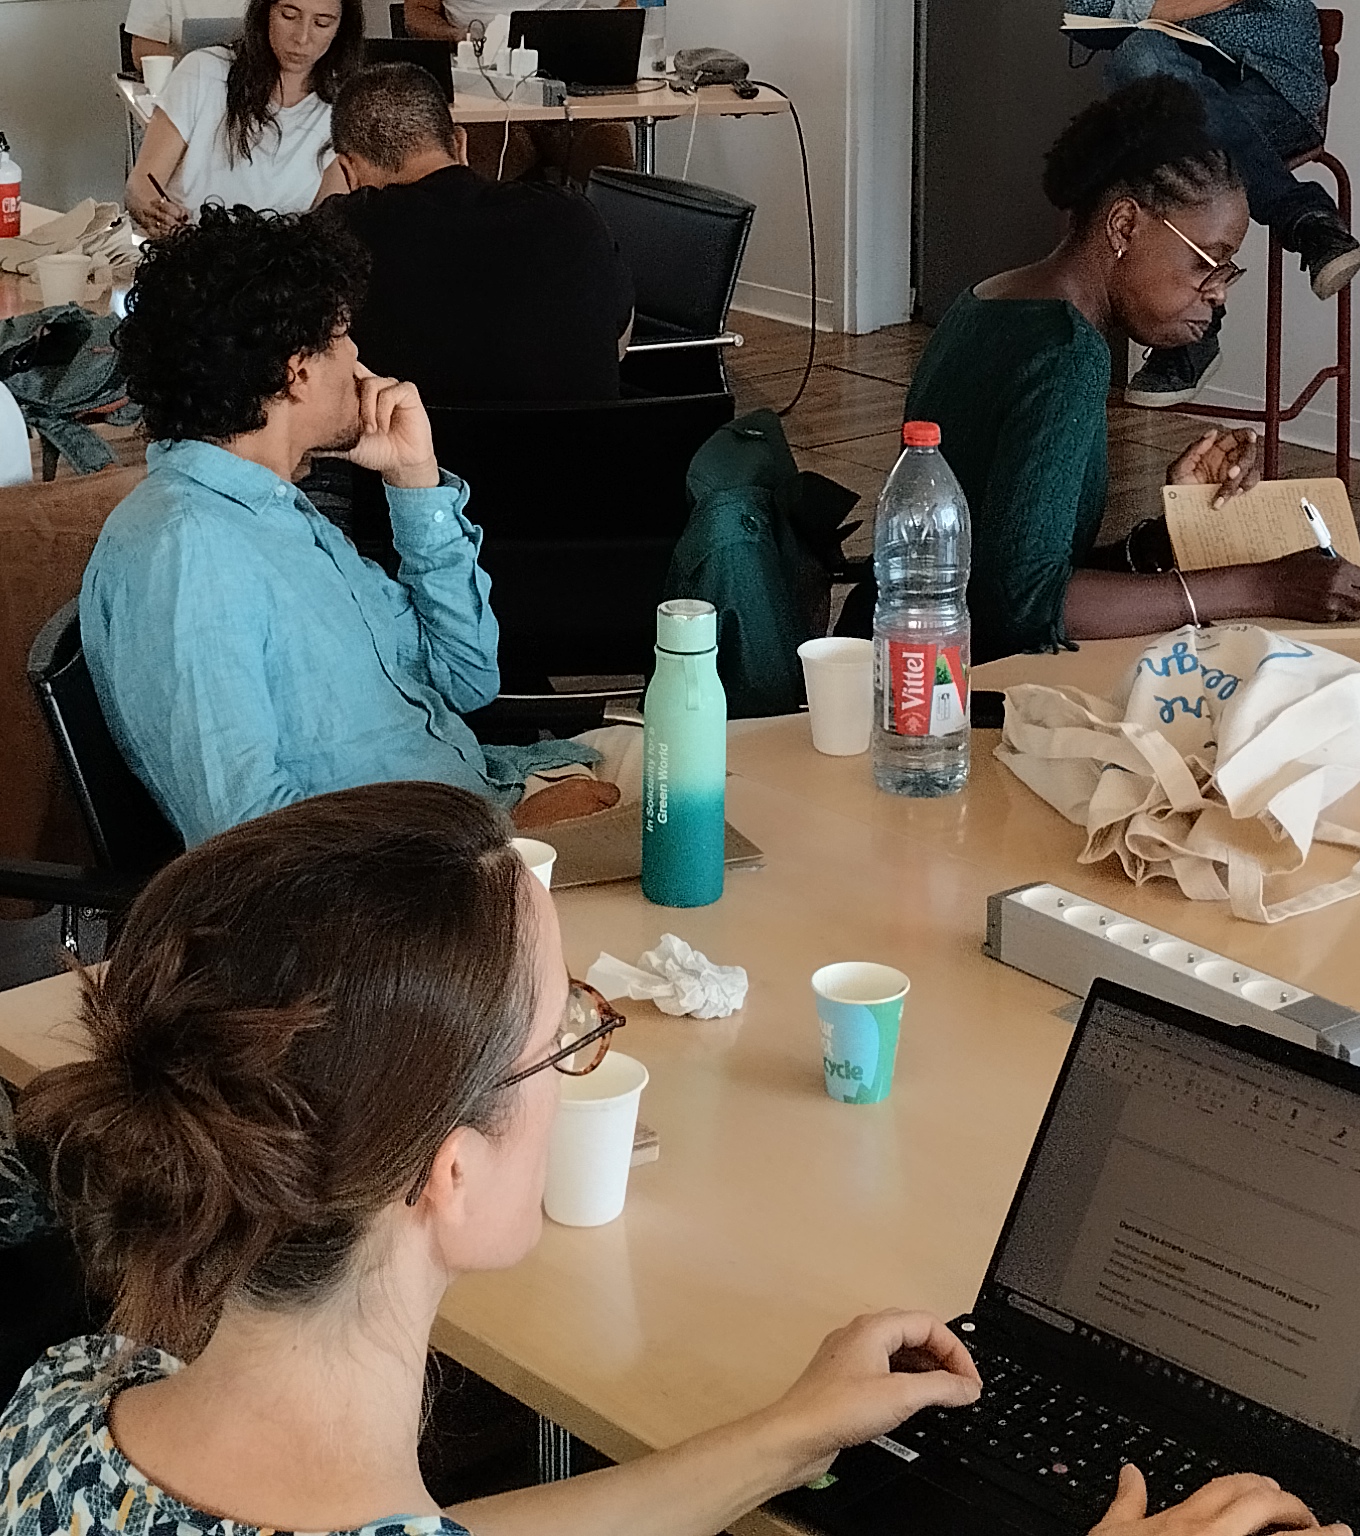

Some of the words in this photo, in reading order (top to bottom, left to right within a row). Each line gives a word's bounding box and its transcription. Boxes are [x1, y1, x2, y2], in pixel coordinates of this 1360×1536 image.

[901, 651, 926, 711] Vittel
[658, 743, 668, 781] World
[646, 758, 655, 818] Solidarity
[657, 783, 668, 824] Green
[645, 819, 654, 833] In
